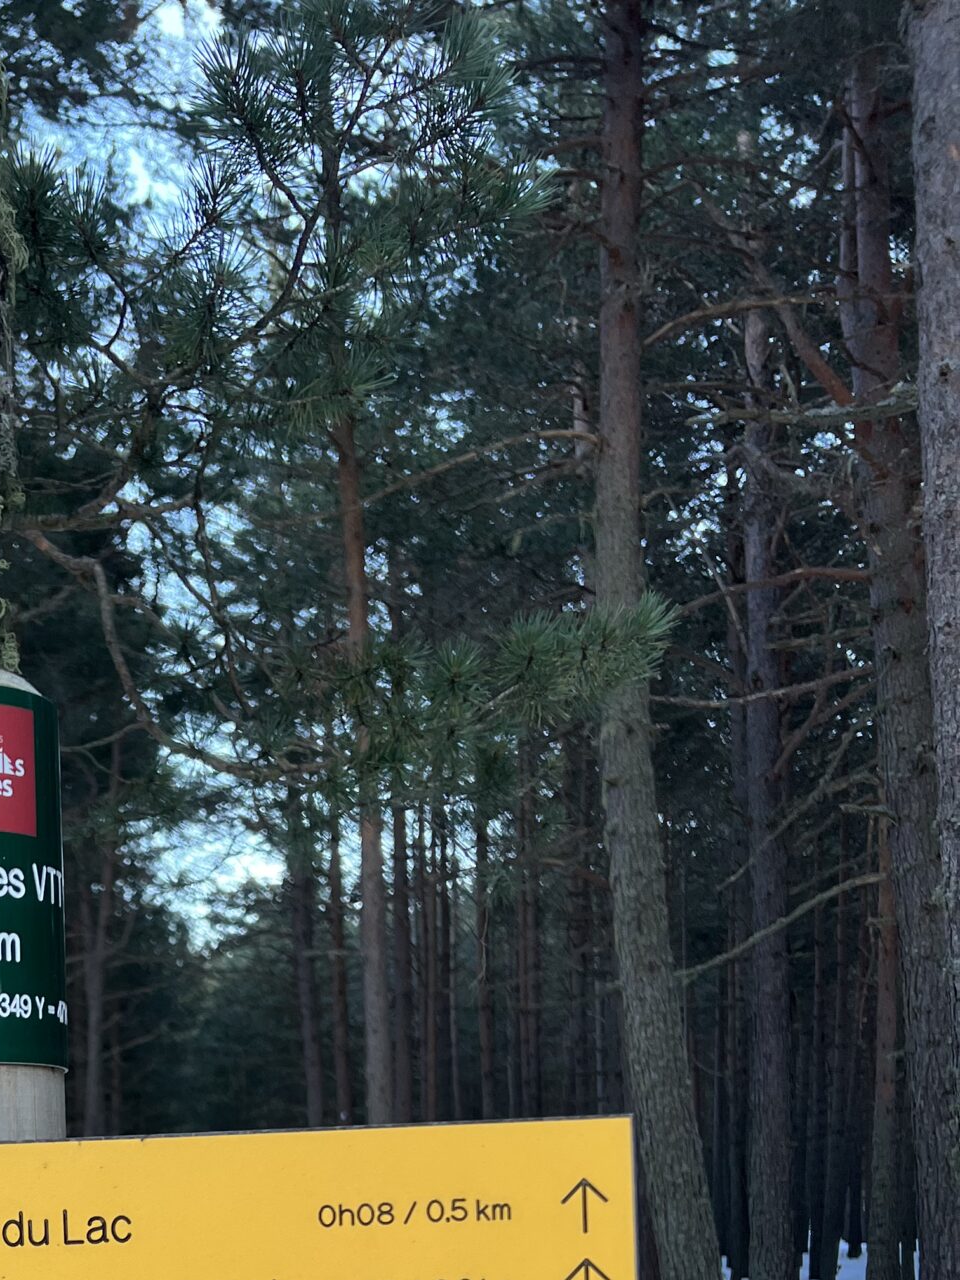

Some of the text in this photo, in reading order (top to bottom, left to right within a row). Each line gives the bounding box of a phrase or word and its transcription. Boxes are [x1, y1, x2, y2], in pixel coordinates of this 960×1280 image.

[35, 995, 45, 1020] Y
[47, 1004, 55, 1015] =
[318, 1198, 513, 1228] 0h08 / 0.5 km
[1, 1210, 50, 1248] du
[62, 1209, 133, 1246] Lac
